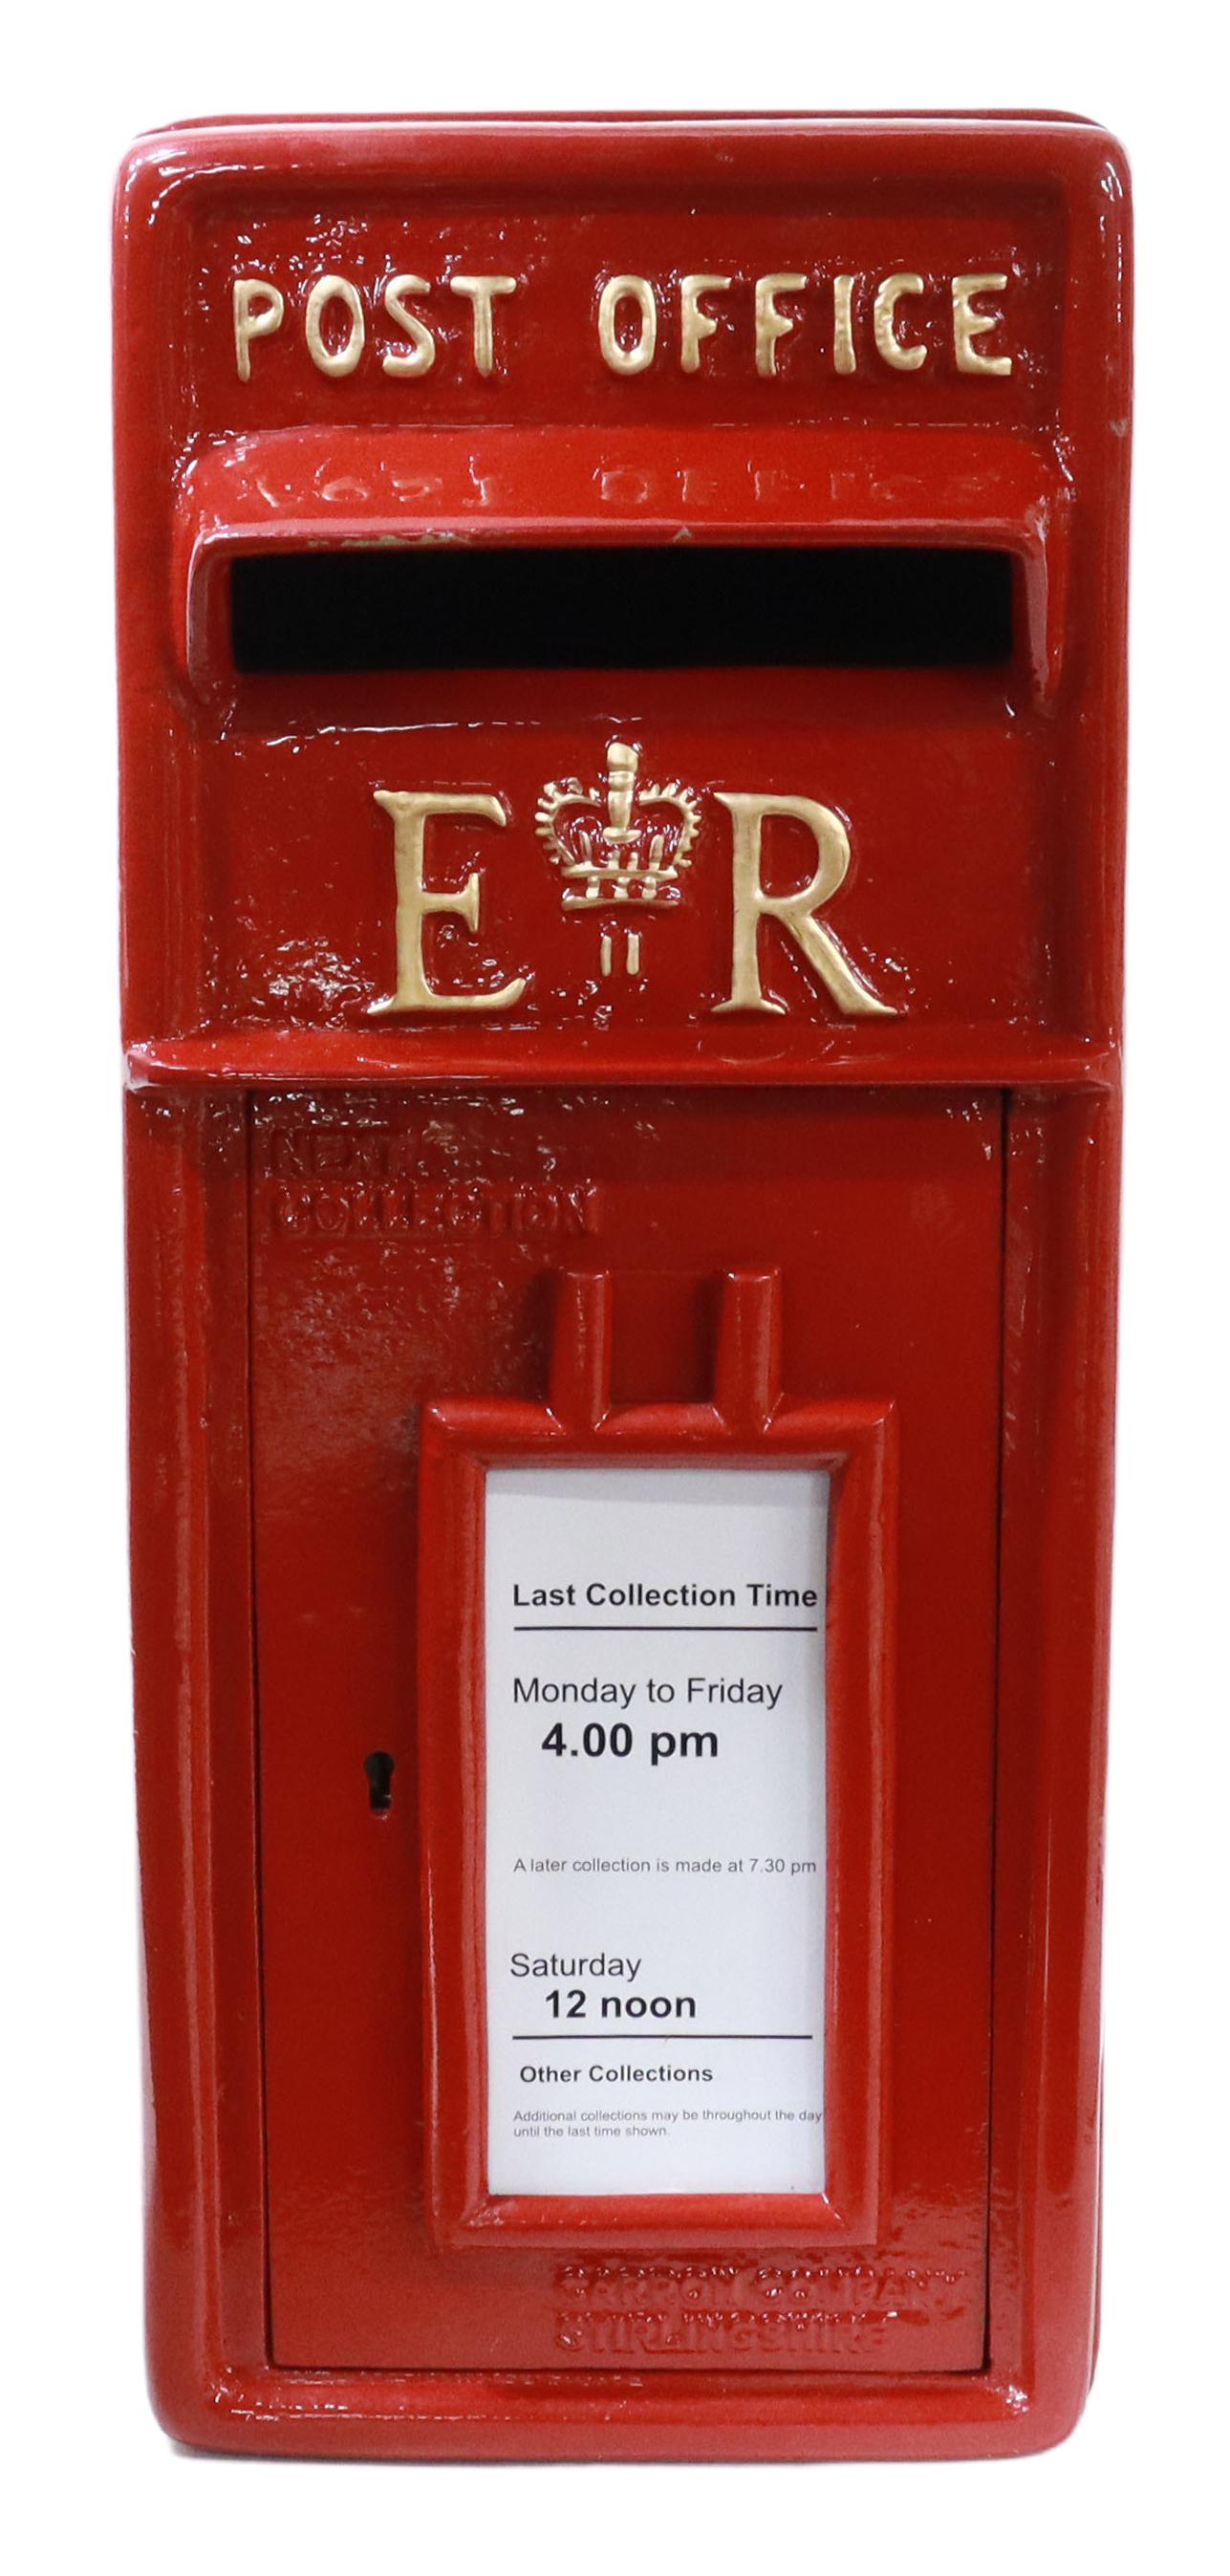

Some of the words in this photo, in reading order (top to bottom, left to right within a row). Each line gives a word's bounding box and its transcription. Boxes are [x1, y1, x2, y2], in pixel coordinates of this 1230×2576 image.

[232, 274, 516, 381] POST
[598, 273, 1013, 377] OFFICE
[367, 790, 527, 1015] E
[711, 791, 896, 1015] R
[513, 1583, 576, 1607] Last
[586, 1583, 736, 1607] Collection
[746, 1584, 818, 1607] Time
[513, 1678, 637, 1710] Monday
[646, 1678, 675, 1703] to
[687, 1678, 784, 1710] Friday
[541, 1722, 634, 1757] 4.00
[651, 1731, 719, 1766] pm
[513, 1858, 527, 1872] A
[530, 1858, 568, 1872] later
[572, 1858, 651, 1872] collection
[657, 1858, 670, 1872] is
[676, 1858, 723, 1872] made
[727, 1859, 744, 1872] at
[749, 1858, 786, 1872] 7.30
[791, 1860, 817, 1876] pm
[509, 1953, 642, 1982] Saturday
[546, 1990, 587, 2019] 12
[601, 1996, 697, 2019] noon
[520, 2066, 582, 2083] Other
[589, 2066, 714, 2083] Collections
[513, 2110, 577, 2122] Additional
[580, 2110, 648, 2122] collections
[652, 2112, 678, 2125] may
[682, 2110, 699, 2121] be
[702, 2110, 772, 2124] throughout
[775, 2110, 795, 2121] the
[799, 2110, 823, 2124] day
[513, 2126, 541, 2137] until
[544, 2126, 565, 2136] the
[568, 2126, 591, 2136] last
[593, 2126, 621, 2136] time
[626, 2126, 671, 2137] shown.
